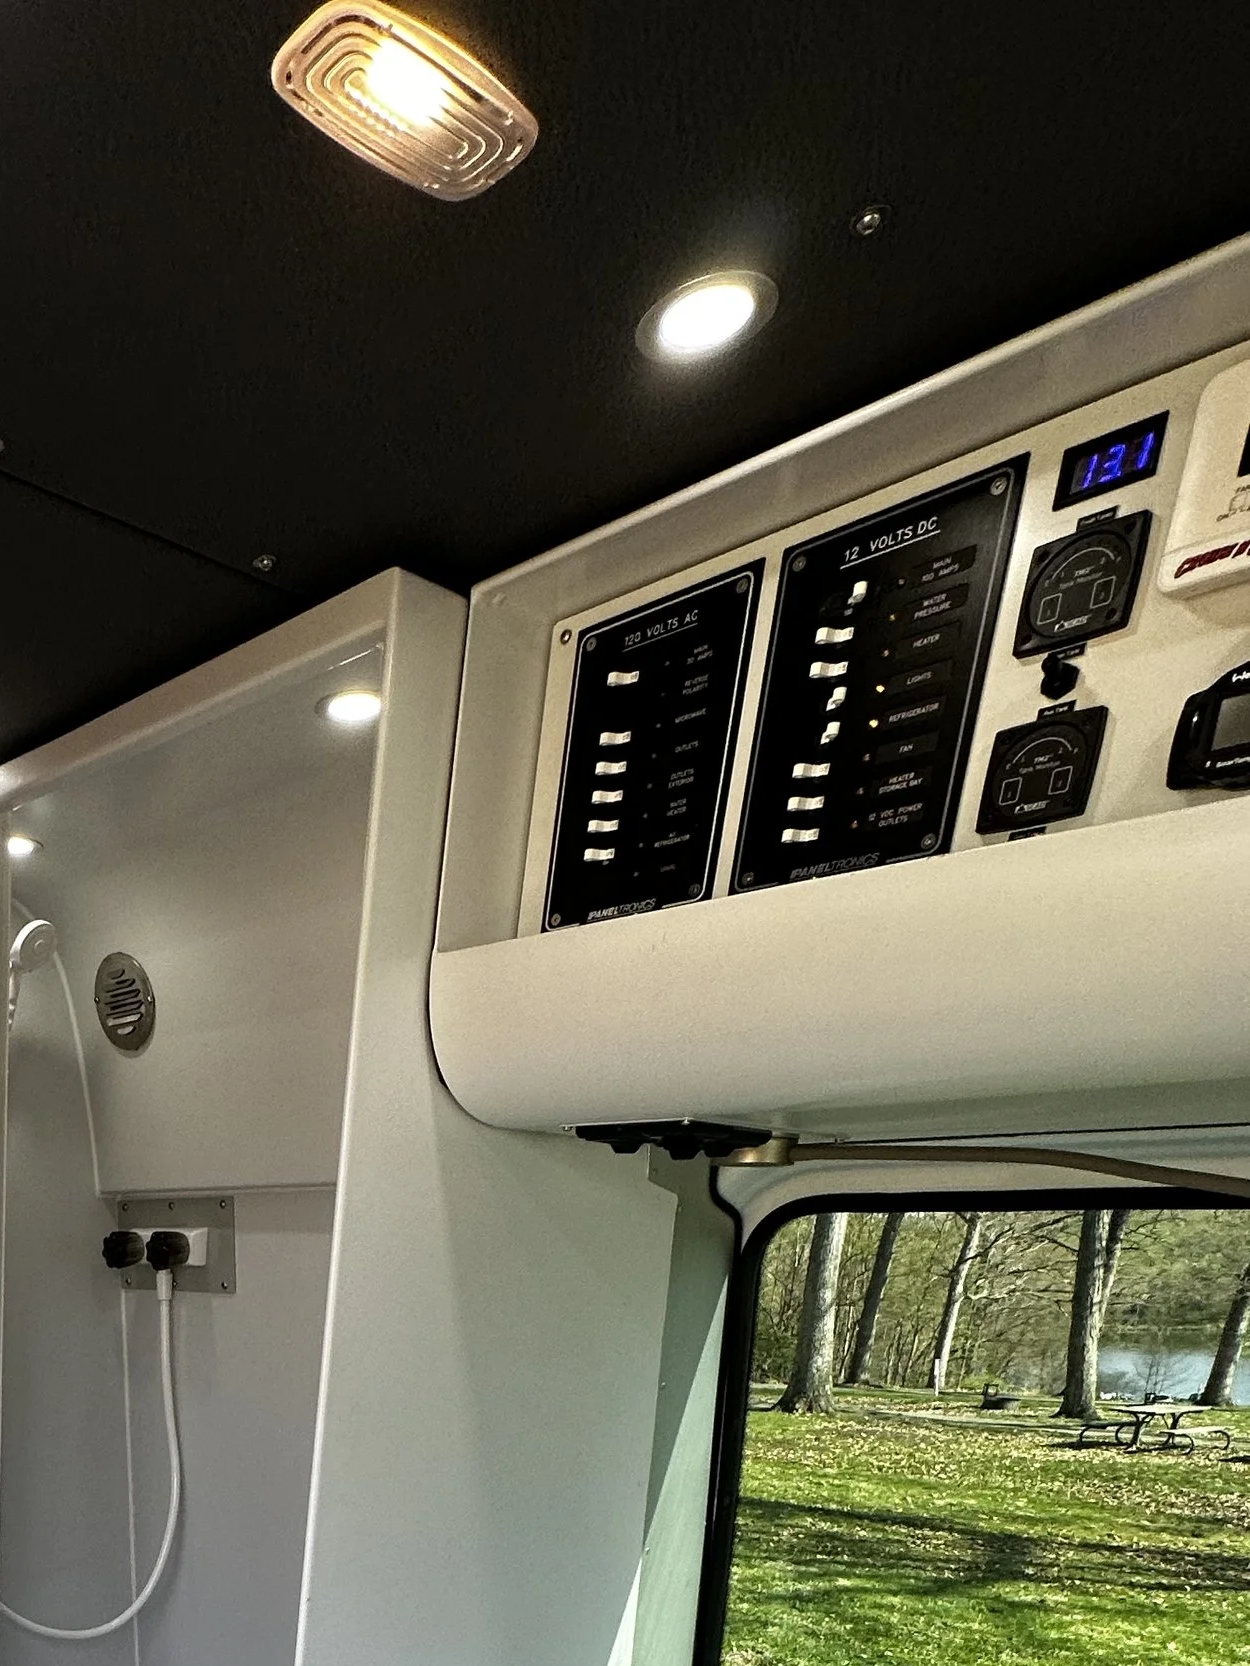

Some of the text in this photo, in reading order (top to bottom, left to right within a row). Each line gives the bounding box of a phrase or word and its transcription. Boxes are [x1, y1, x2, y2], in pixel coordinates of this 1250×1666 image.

[844, 516, 939, 562] 12 VOLTS DC
[932, 556, 952, 569] MAIN
[938, 563, 959, 577] AMPS
[922, 593, 947, 607] WATER
[914, 601, 951, 619] PRESSURE
[624, 609, 699, 646] 120 VOLTS AC
[912, 633, 940, 648] HEATER
[906, 671, 933, 685] LIGHTS
[888, 702, 939, 723] REFRIGERATOR
[675, 740, 699, 753] OUTLETS
[899, 743, 913, 754] FAN
[888, 772, 915, 784] HEATER
[898, 803, 923, 816] POWER
[878, 815, 908, 828] OUTLETS
